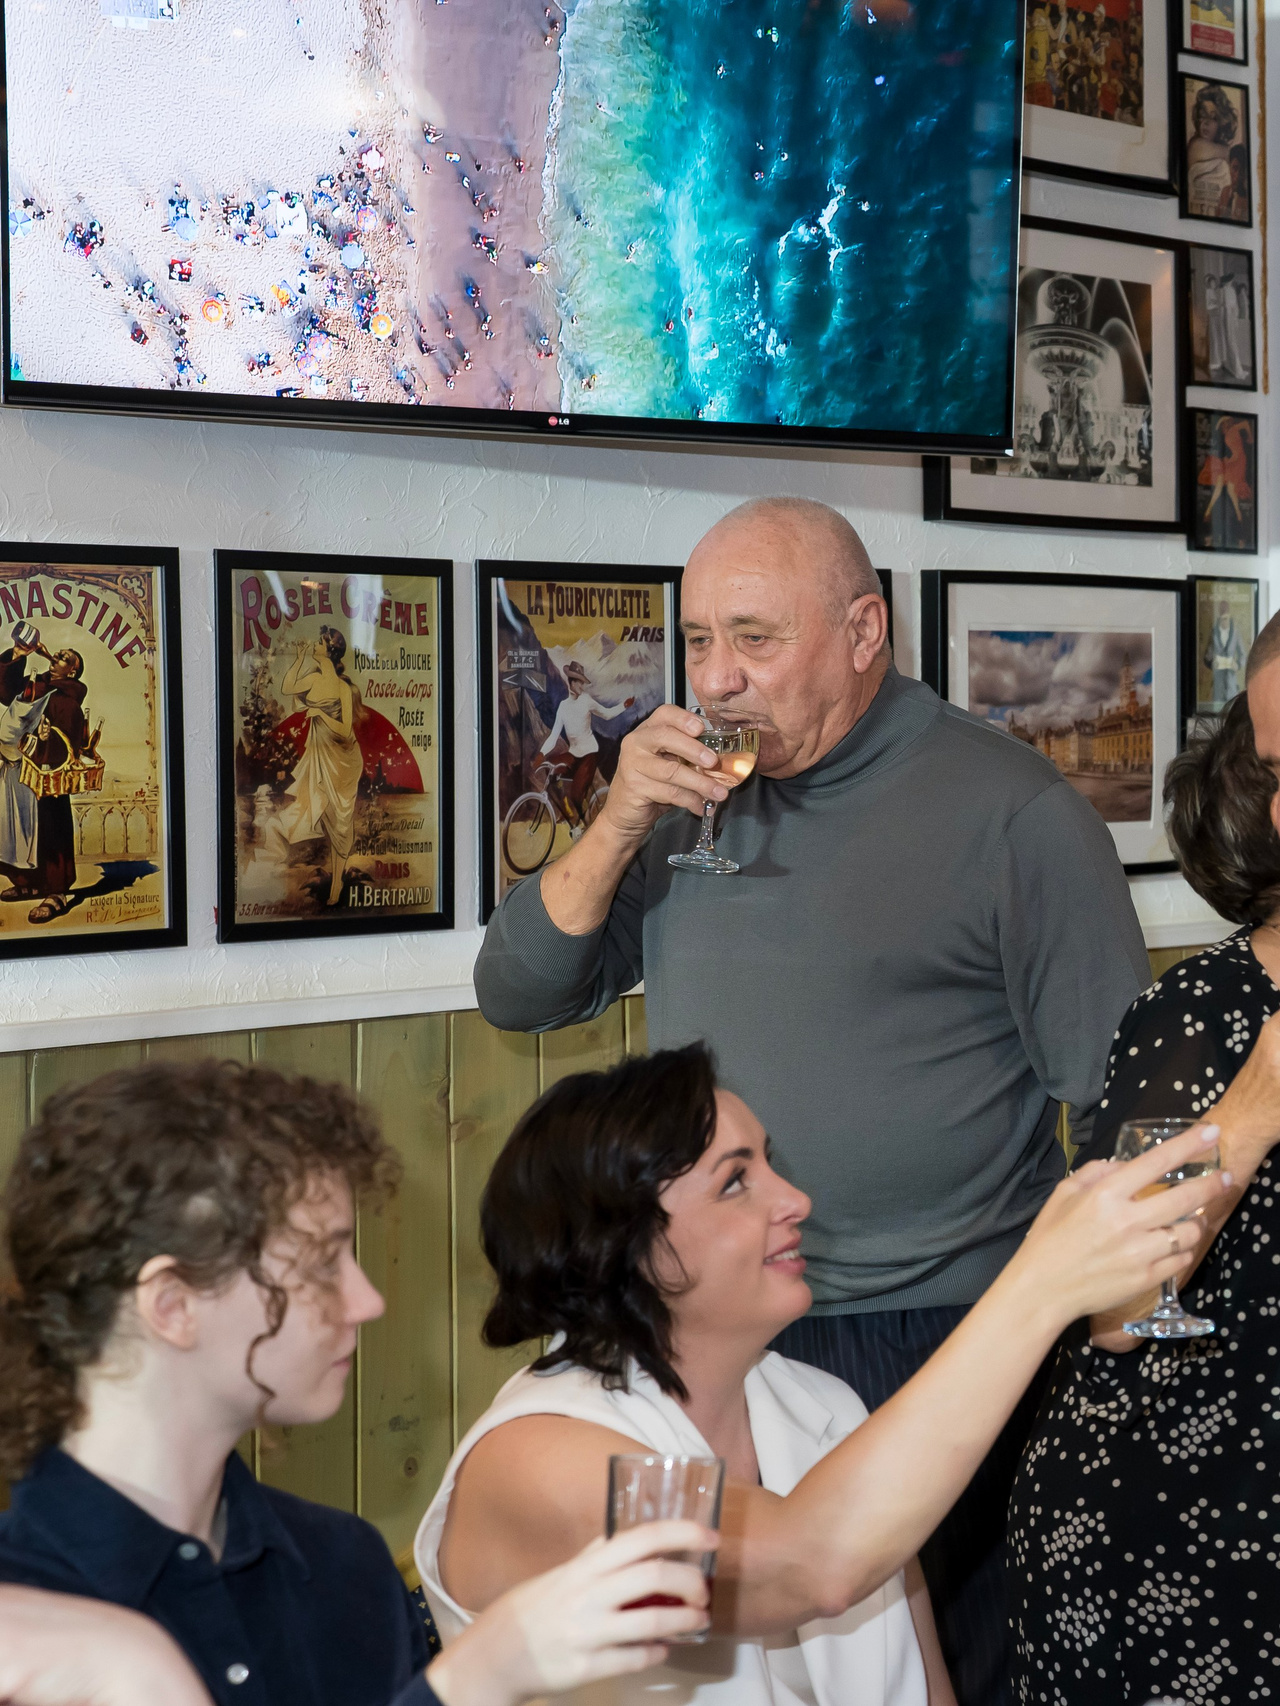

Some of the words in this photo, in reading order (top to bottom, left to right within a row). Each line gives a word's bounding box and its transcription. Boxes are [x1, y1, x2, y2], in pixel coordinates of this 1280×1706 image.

[527, 585, 544, 616] LA
[545, 583, 651, 624] TOURICYCLETTE
[0, 580, 147, 669] NASTINE
[620, 626, 665, 643] PARIS
[391, 660, 399, 670] LA
[400, 647, 432, 671] BOUCHE
[365, 679, 397, 698] Rosée
[405, 679, 433, 702] Corps
[411, 730, 432, 752] neige
[375, 860, 411, 880] PARIS
[90, 897, 114, 911] Exiger
[115, 894, 123, 905] la
[123, 892, 160, 909] Signature
[363, 885, 433, 908] BERTRAND
